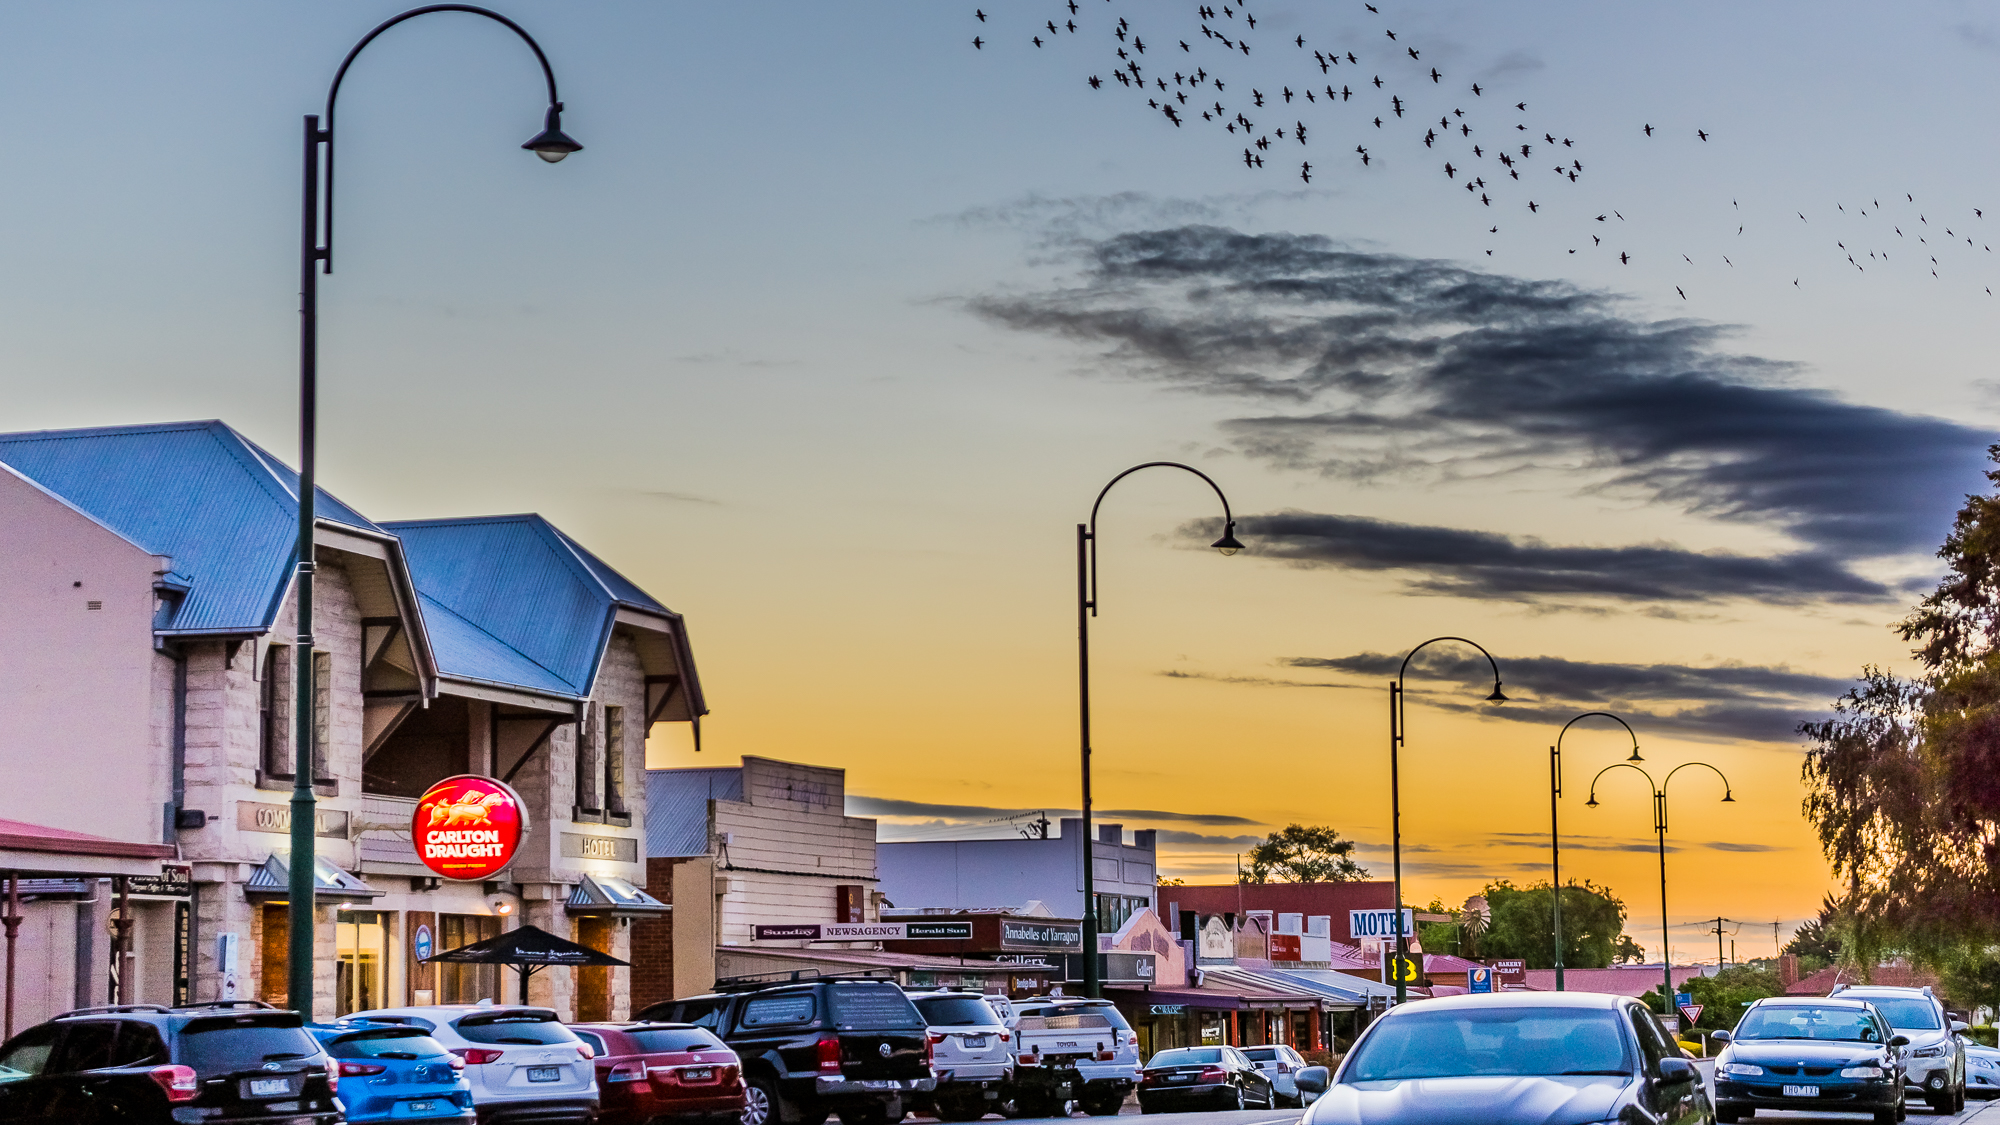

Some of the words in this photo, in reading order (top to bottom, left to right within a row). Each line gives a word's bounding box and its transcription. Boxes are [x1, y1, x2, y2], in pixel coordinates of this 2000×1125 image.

[257, 808, 329, 832] COMMAL
[426, 830, 500, 844] CARLTON
[424, 843, 504, 858] DRAUGHT
[583, 838, 616, 857] HOTEL
[763, 928, 816, 937] Sunday
[826, 927, 901, 936] NEWSAGENCY
[1353, 912, 1410, 936] MOTEL
[1005, 925, 1040, 941] Annabelles
[1041, 927, 1050, 941] of
[1050, 927, 1079, 945] Yarragon
